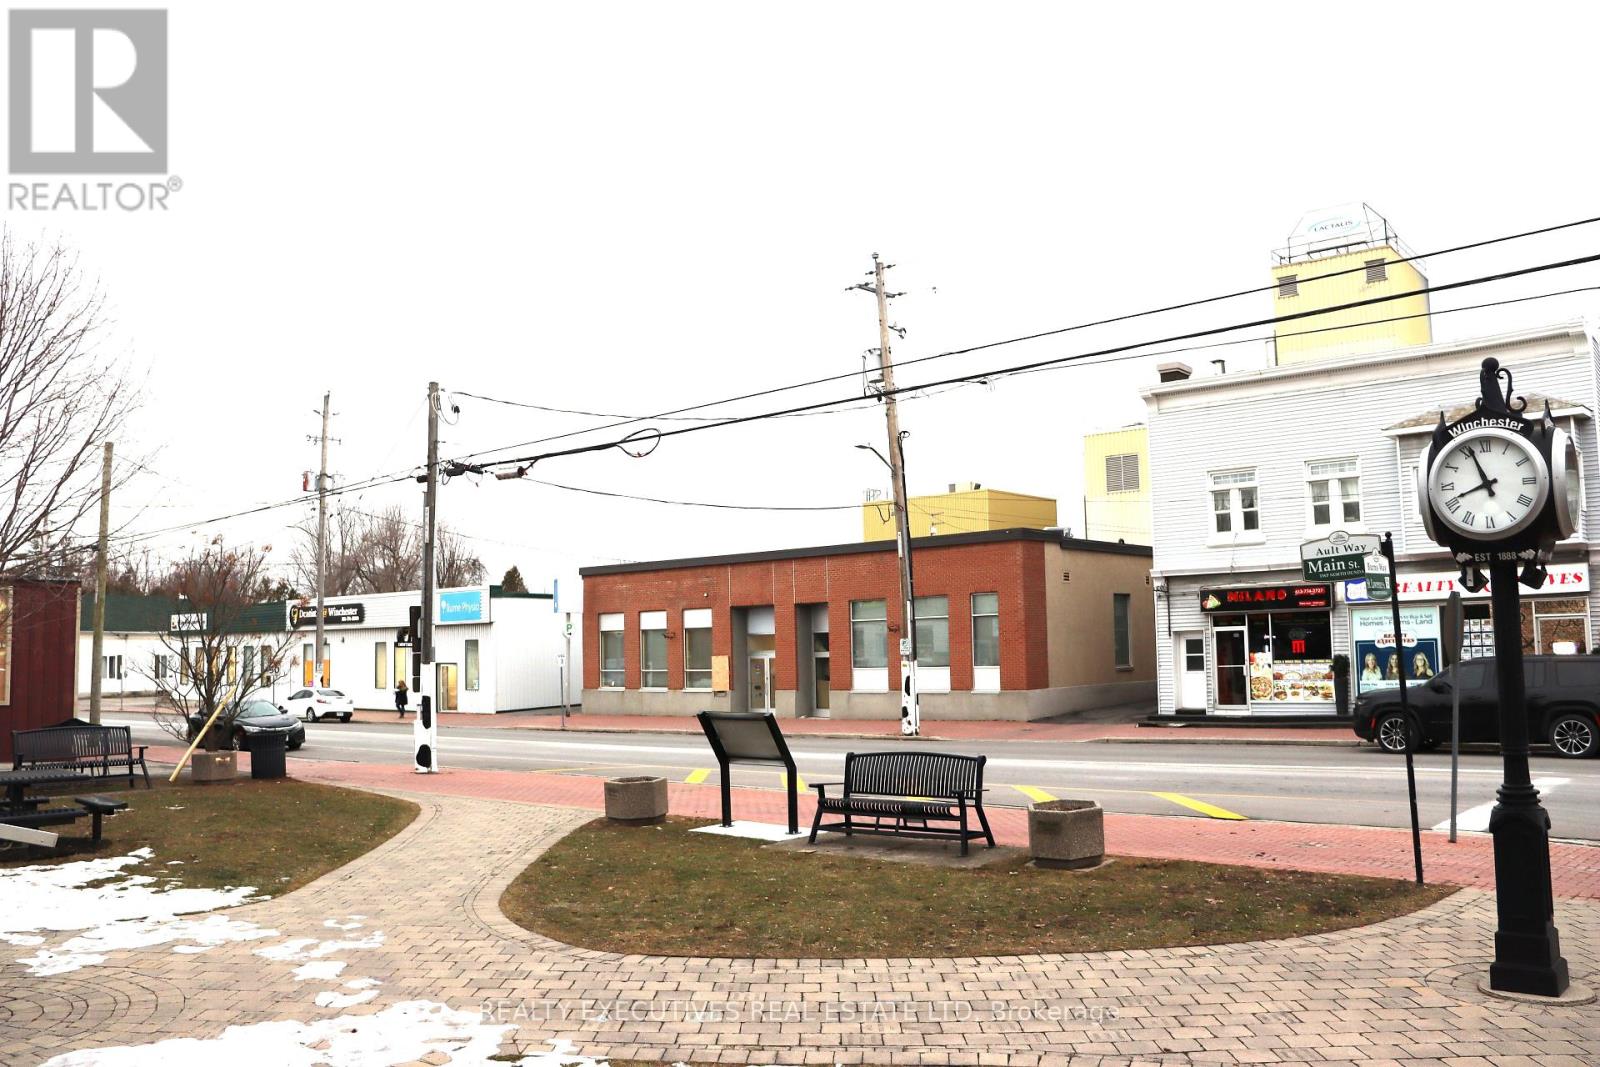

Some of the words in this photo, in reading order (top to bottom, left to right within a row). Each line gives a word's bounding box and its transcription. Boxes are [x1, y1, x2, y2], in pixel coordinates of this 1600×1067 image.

[1314, 220, 1353, 232] LACTALIS
[1448, 417, 1524, 438] Winchester
[1316, 546, 1339, 556] Ault
[1343, 543, 1367, 554] Way
[1474, 553, 1491, 561] EST
[1498, 551, 1517, 560] 1888
[1308, 558, 1346, 574] Main
[1348, 560, 1360, 569] St.
[328, 606, 358, 617] Winchester
